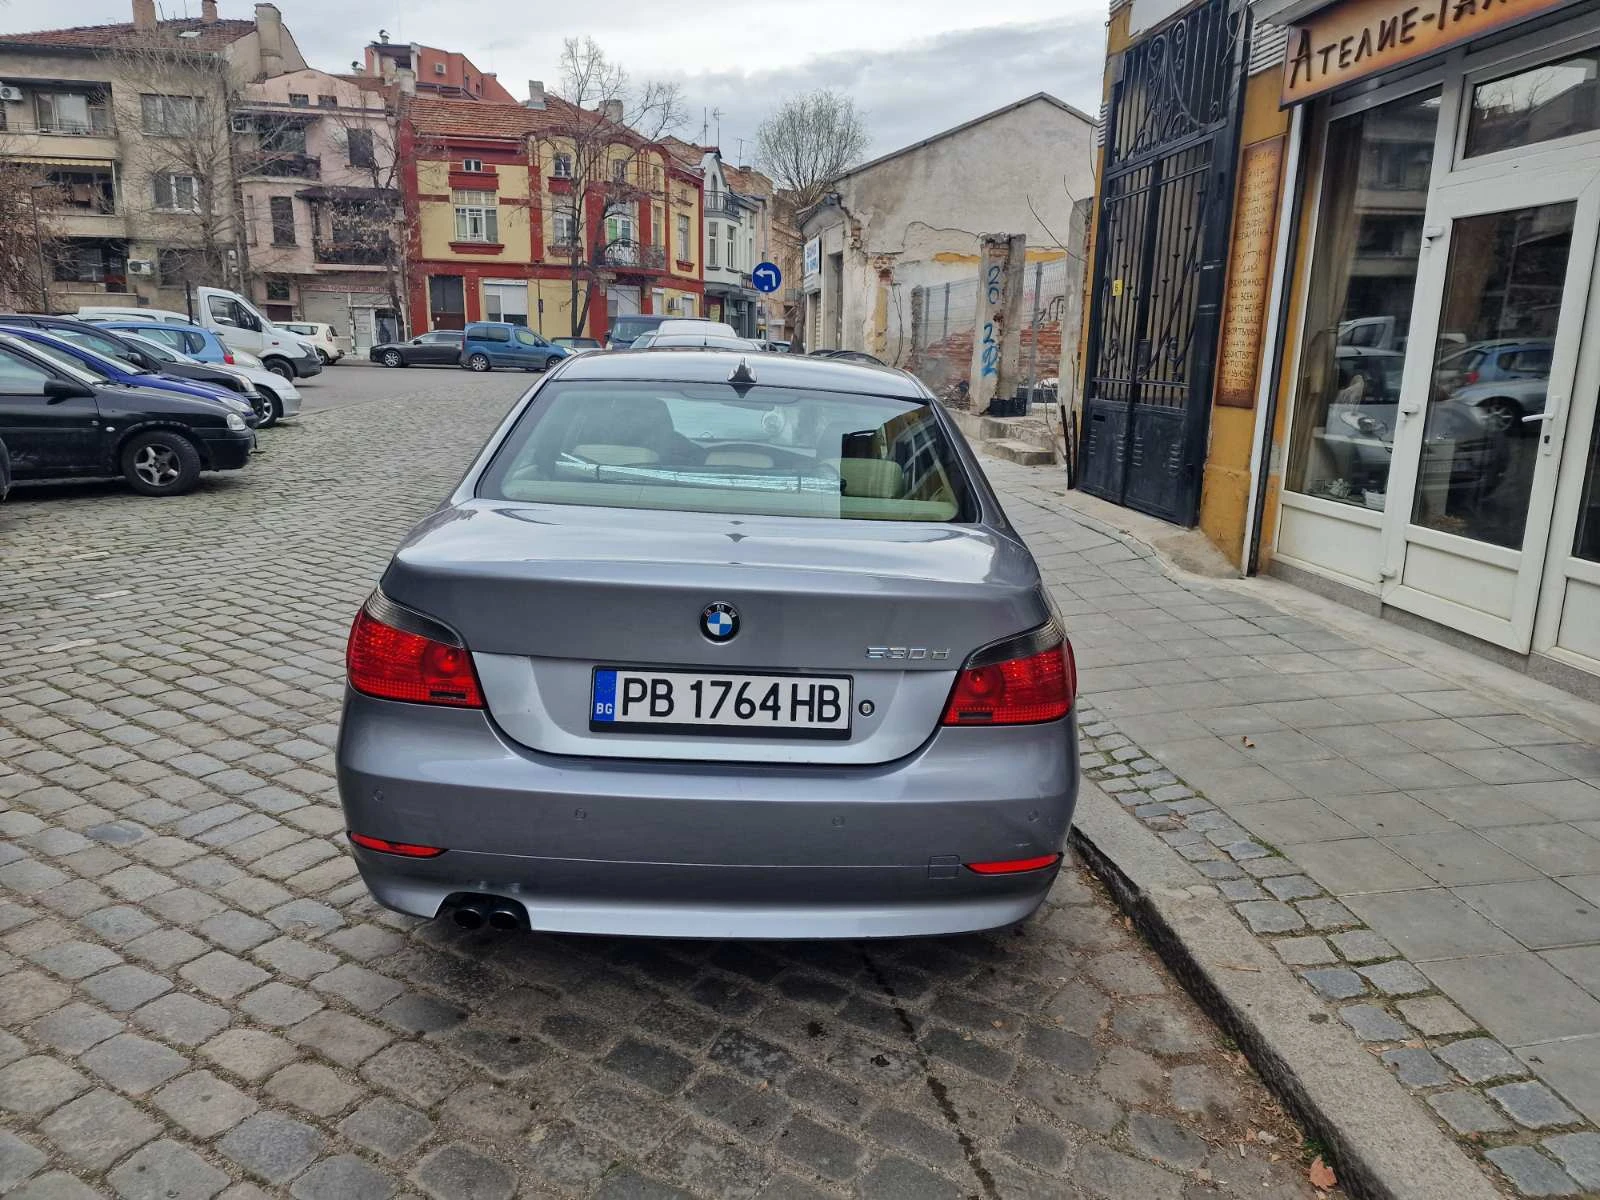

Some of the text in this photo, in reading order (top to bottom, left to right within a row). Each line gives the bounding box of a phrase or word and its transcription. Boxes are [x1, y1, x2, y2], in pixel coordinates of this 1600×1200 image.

[704, 604, 737, 618] BMW
[622, 677, 842, 723] PB 1764 HB
[596, 703, 613, 715] BG
